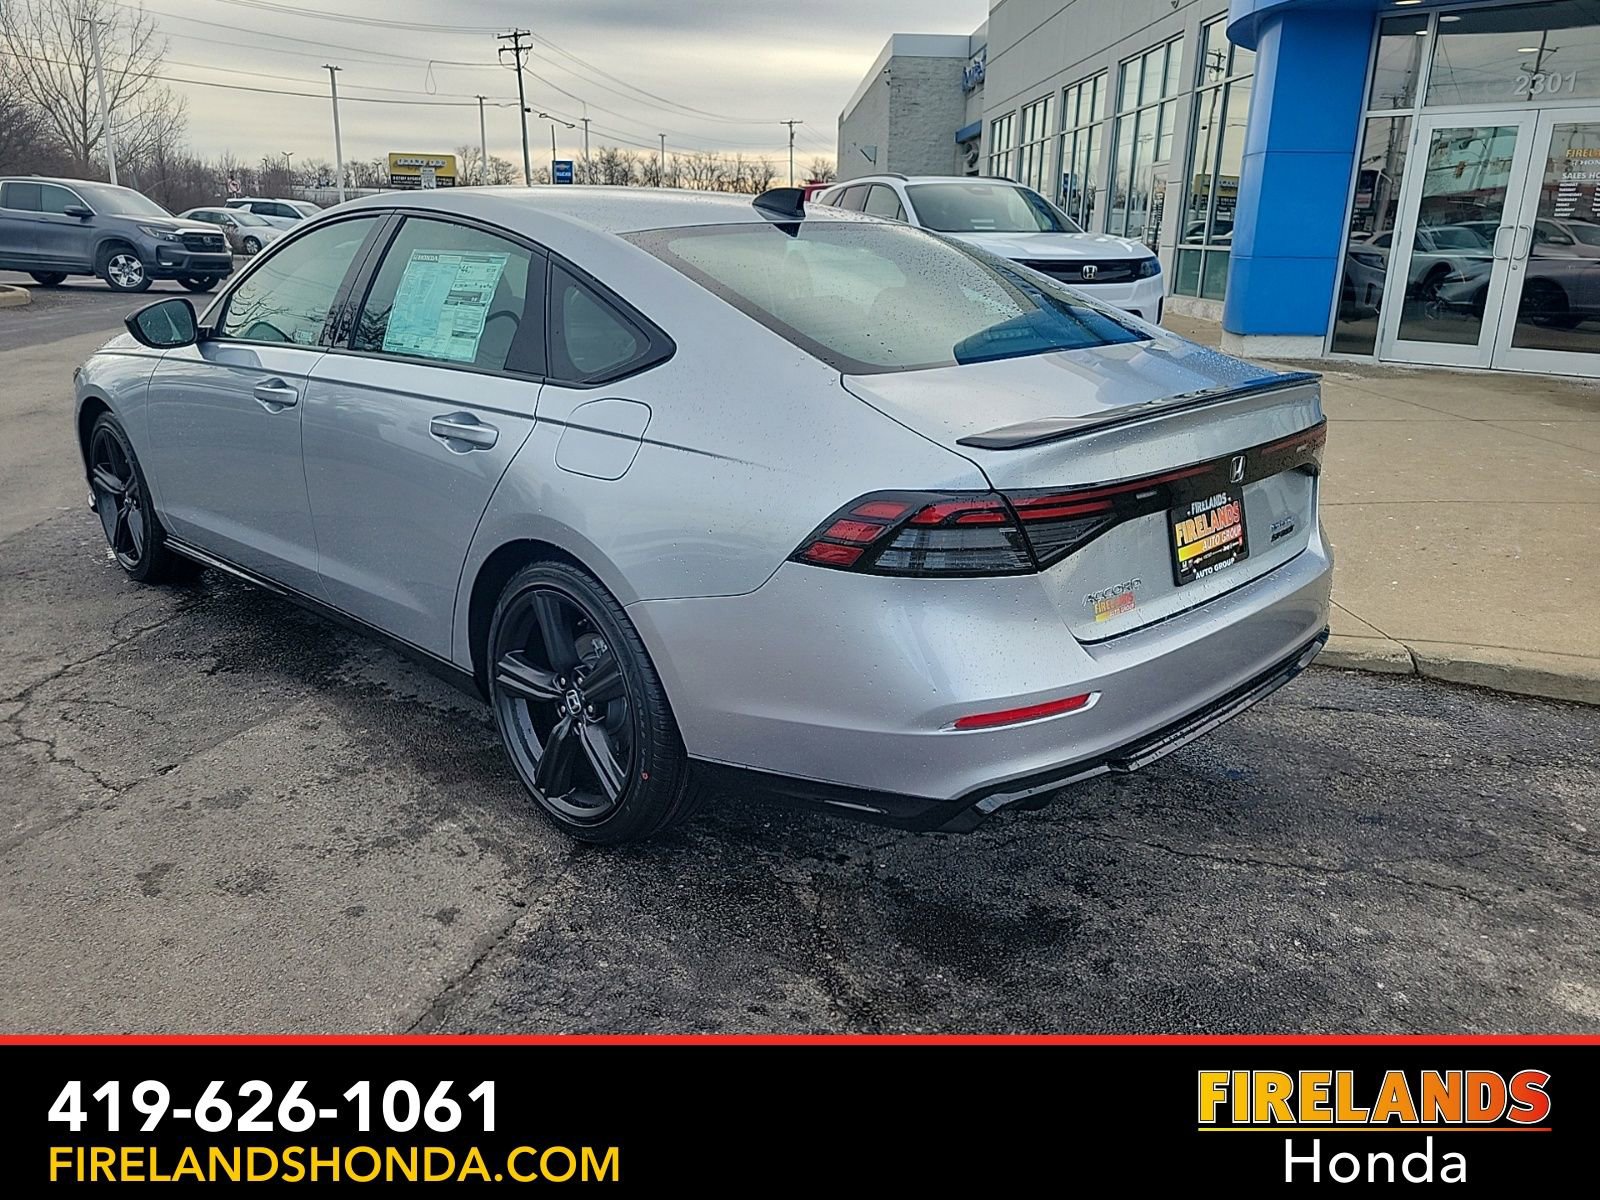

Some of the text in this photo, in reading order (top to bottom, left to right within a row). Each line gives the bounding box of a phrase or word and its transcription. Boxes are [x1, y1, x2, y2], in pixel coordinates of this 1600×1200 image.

[1513, 71, 1578, 96] 2301
[1191, 492, 1227, 516] FIRELANDS
[1175, 500, 1241, 547] FIRELANDS
[1203, 535, 1220, 550] AUTO
[1195, 567, 1214, 580] AUTO
[1213, 557, 1235, 571] GROUP
[1082, 577, 1142, 607] ACCORD
